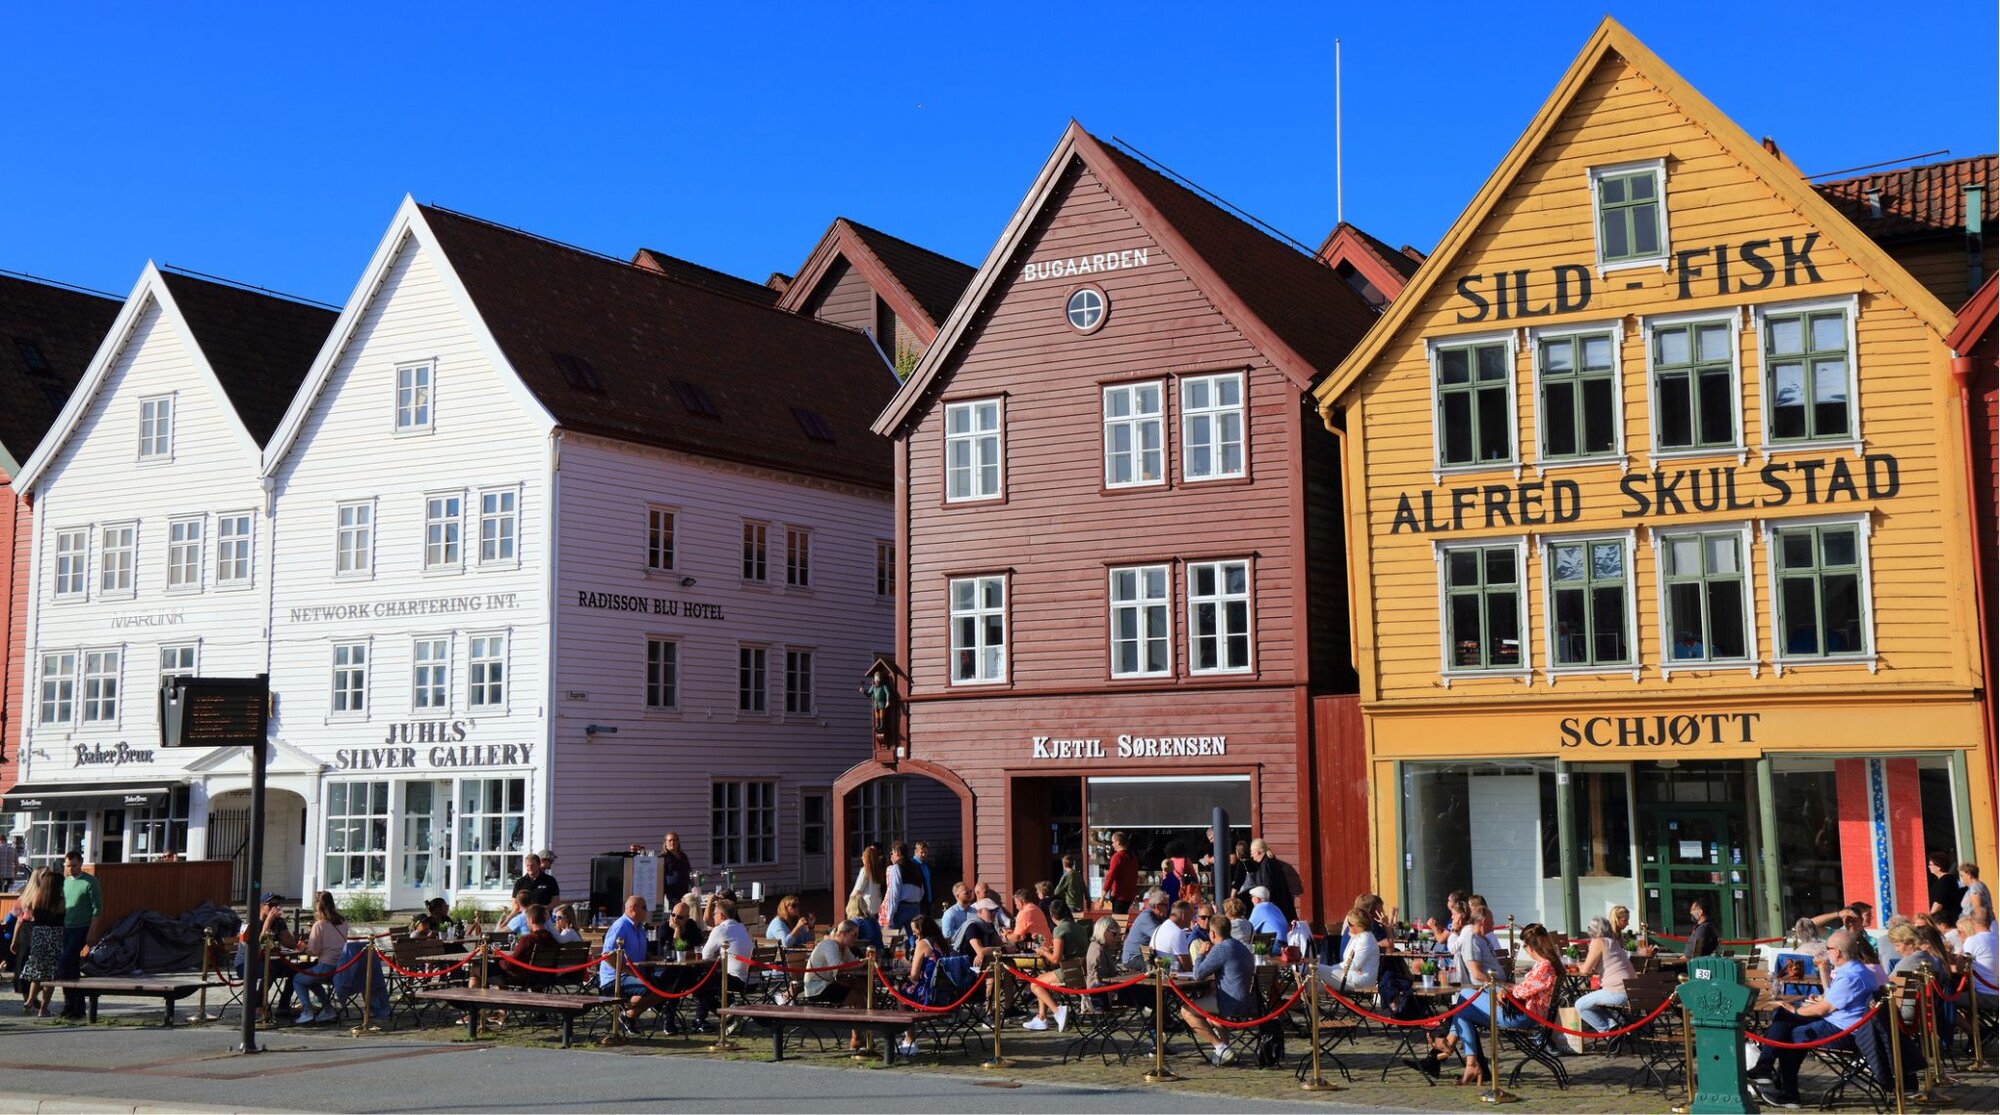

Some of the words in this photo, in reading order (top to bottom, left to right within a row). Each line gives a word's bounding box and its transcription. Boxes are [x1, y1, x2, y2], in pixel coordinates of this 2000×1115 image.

[1024, 248, 1148, 281] BUGAARDEN
[1456, 264, 1592, 323] SILD
[1677, 233, 1824, 299] FISK
[1390, 479, 1581, 535] ALFRED
[1619, 453, 1901, 519] SKULSTAD
[111, 608, 185, 628] MARLINK
[289, 603, 370, 623] NETWORK
[373, 595, 483, 617] CHARTERING
[487, 593, 520, 609] INT.
[578, 590, 649, 613] RADISSON
[653, 598, 679, 616] BLU
[683, 601, 725, 620] HOTEL
[1560, 712, 1760, 749] SCHJØTT
[73, 742, 117, 769] Baker
[335, 746, 417, 769] SILVER
[428, 743, 534, 767] GALLERY
[1698, 970, 1710, 978] 39
